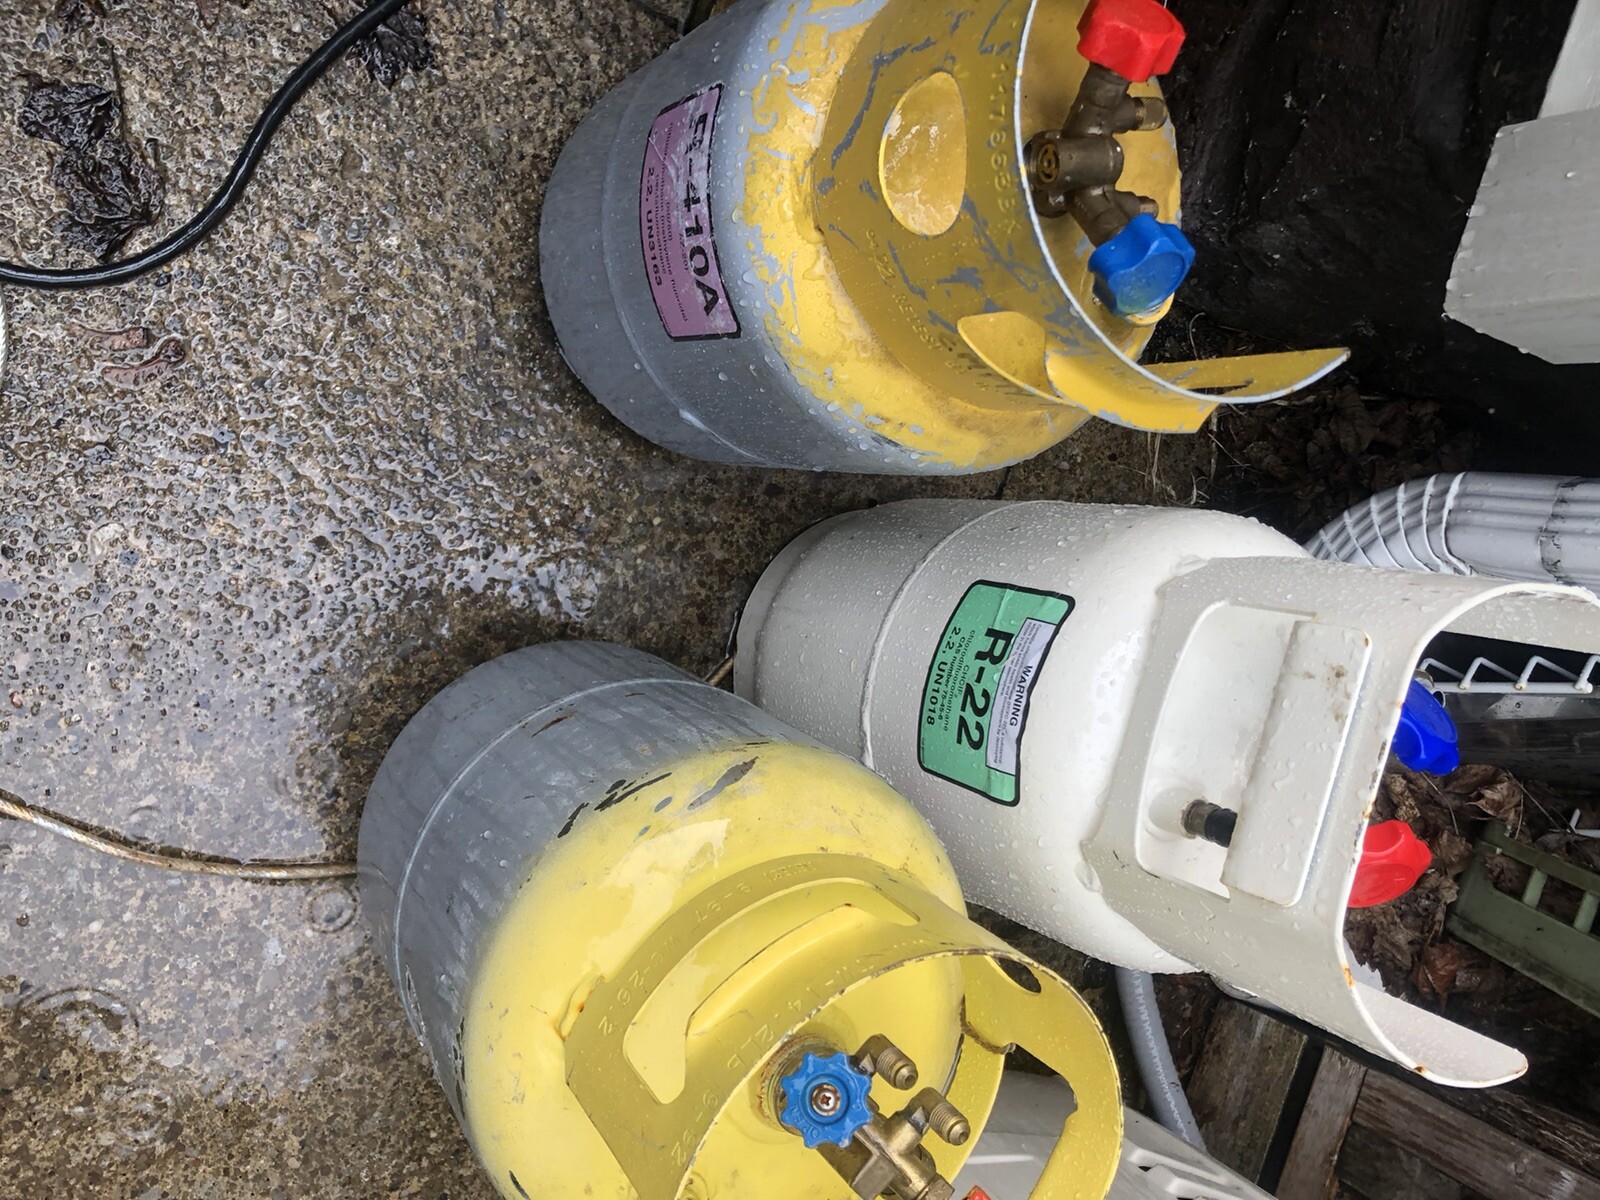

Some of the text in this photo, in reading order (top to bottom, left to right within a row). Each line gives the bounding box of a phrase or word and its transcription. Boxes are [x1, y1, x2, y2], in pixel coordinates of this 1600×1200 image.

[646, 209, 663, 286] UN3163
[683, 113, 720, 316] R-410A
[670, 279, 688, 322] fluoride)
[926, 626, 961, 726] 2.2, UN1018
[943, 655, 957, 689] number
[943, 629, 976, 732] chlorodifluoromethane
[954, 636, 966, 655] CAS
[956, 628, 1014, 751] R-22
[1009, 665, 1033, 727] WARNING
